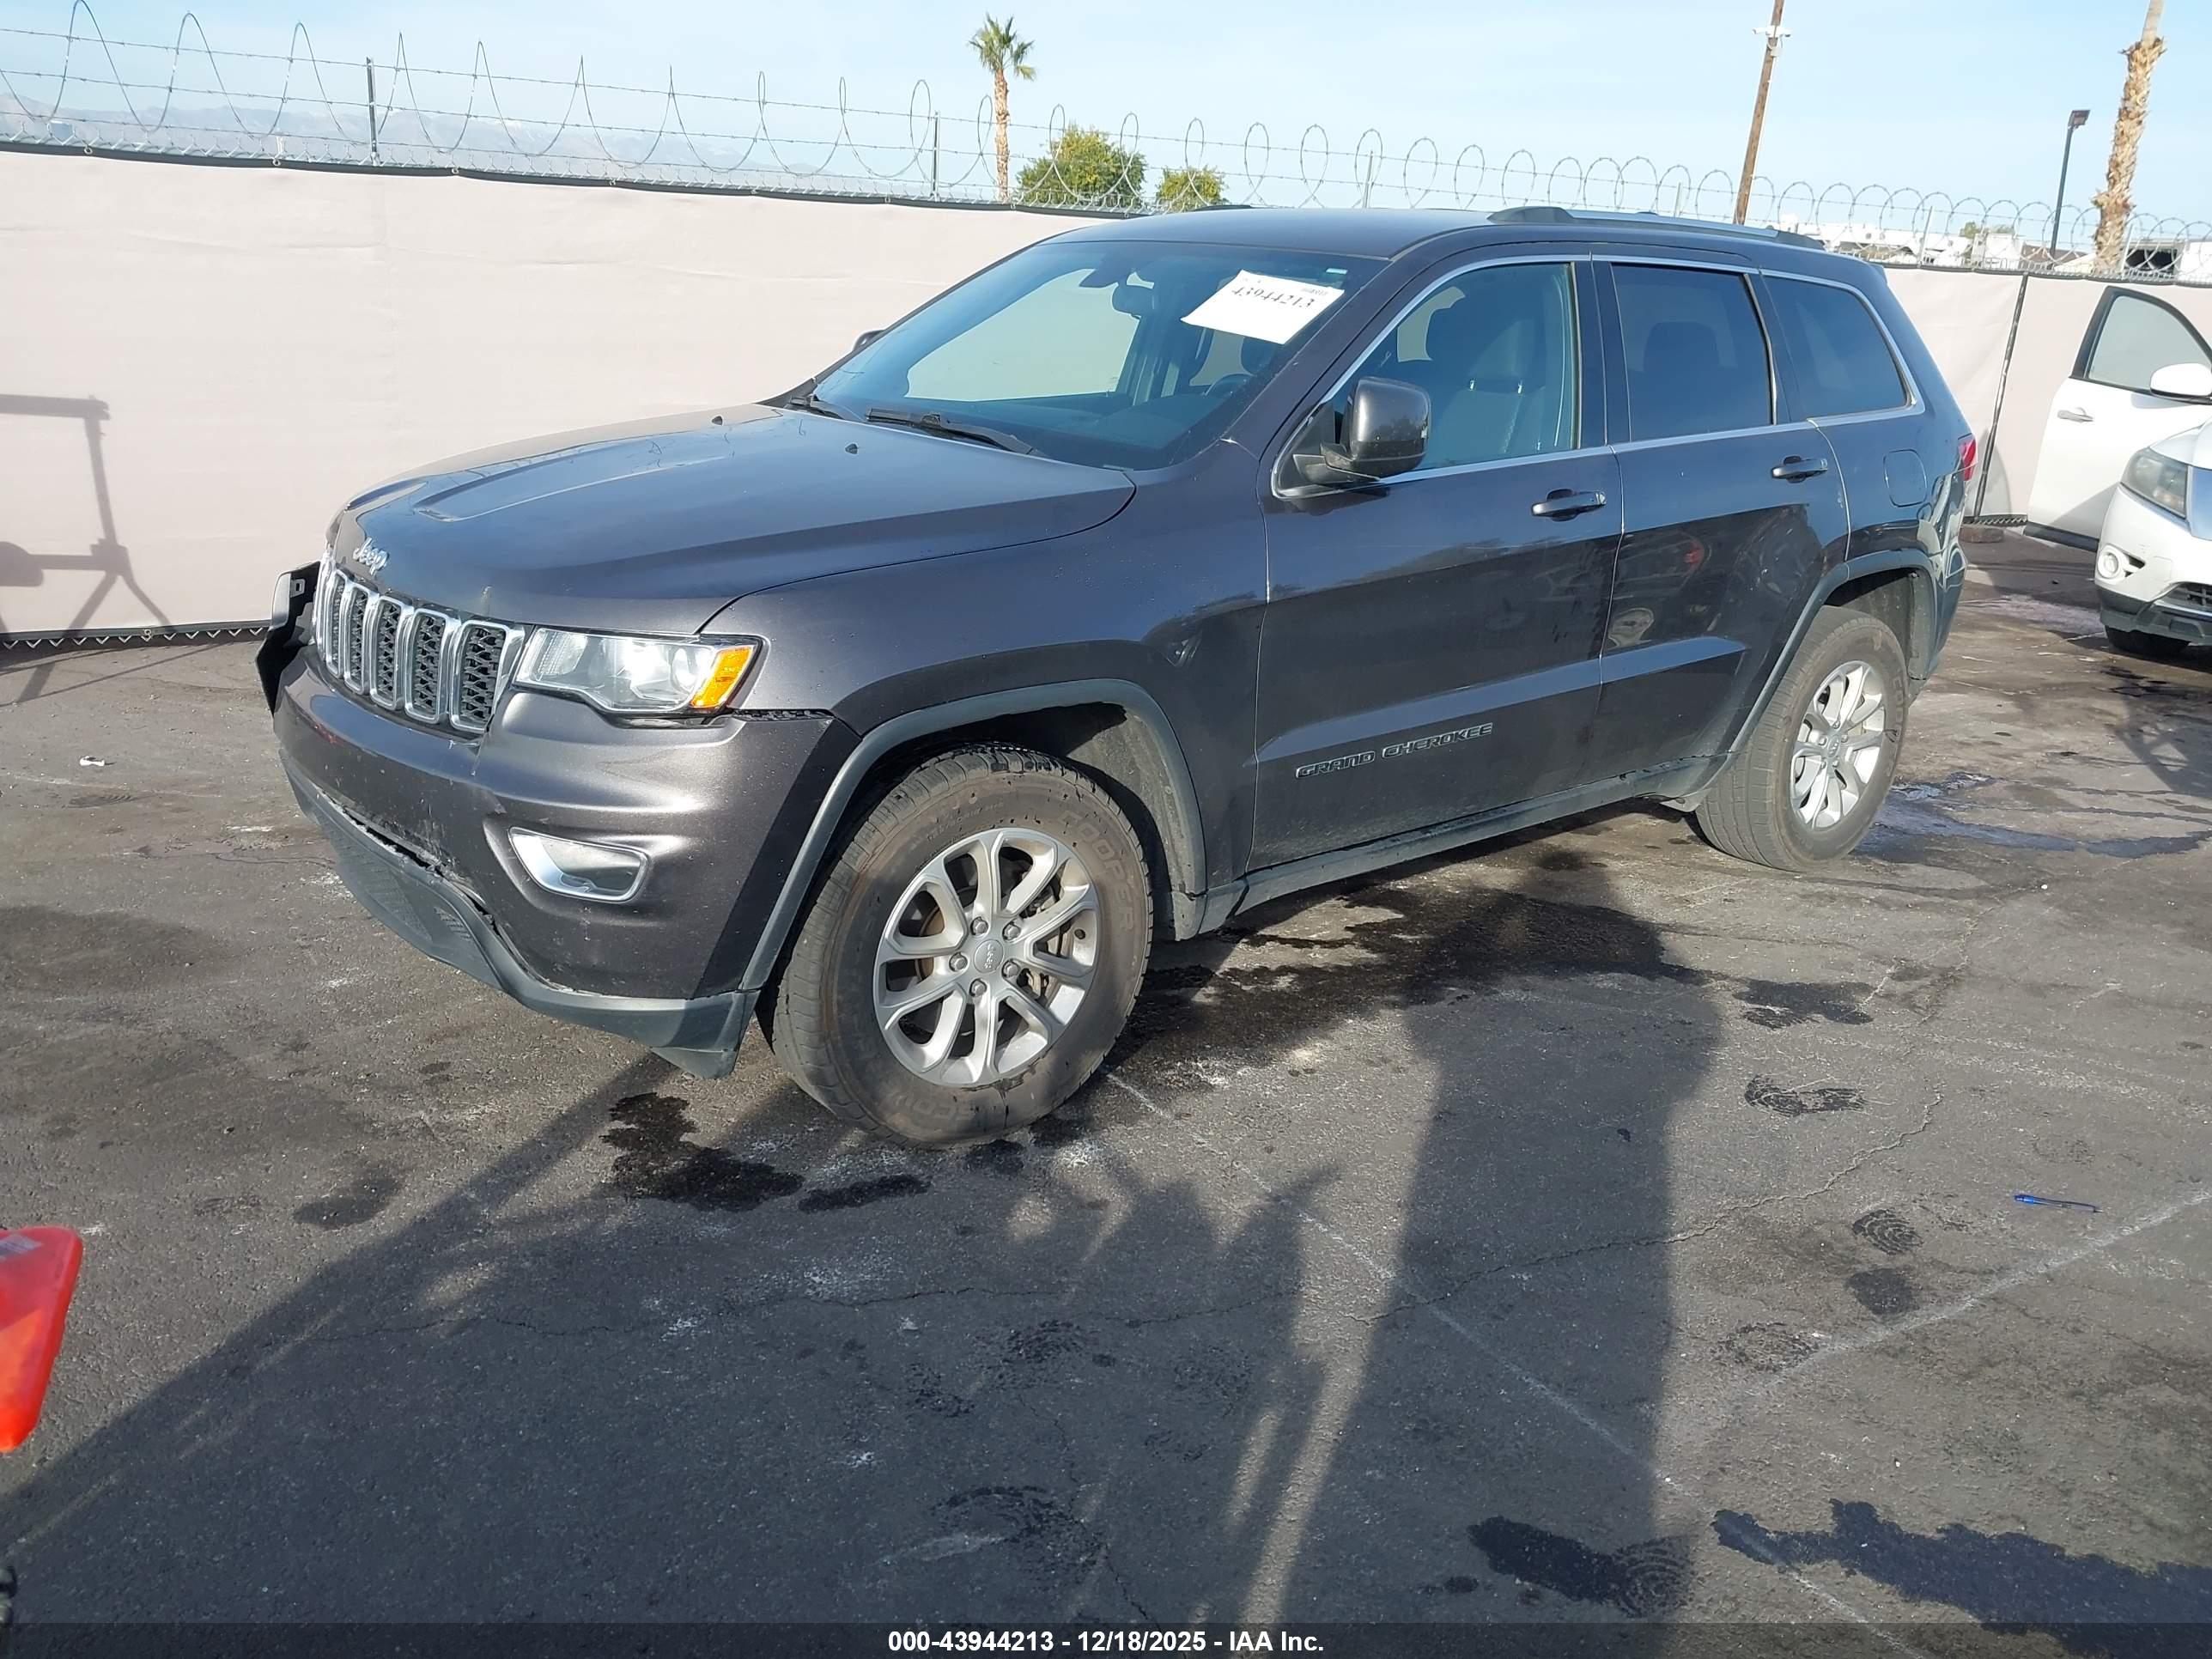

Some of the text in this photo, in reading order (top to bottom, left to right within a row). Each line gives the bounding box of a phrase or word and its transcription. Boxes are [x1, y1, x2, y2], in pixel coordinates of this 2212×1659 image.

[352, 537, 389, 576] Jeep
[1295, 722, 1493, 779] GRAND CHEROKEE
